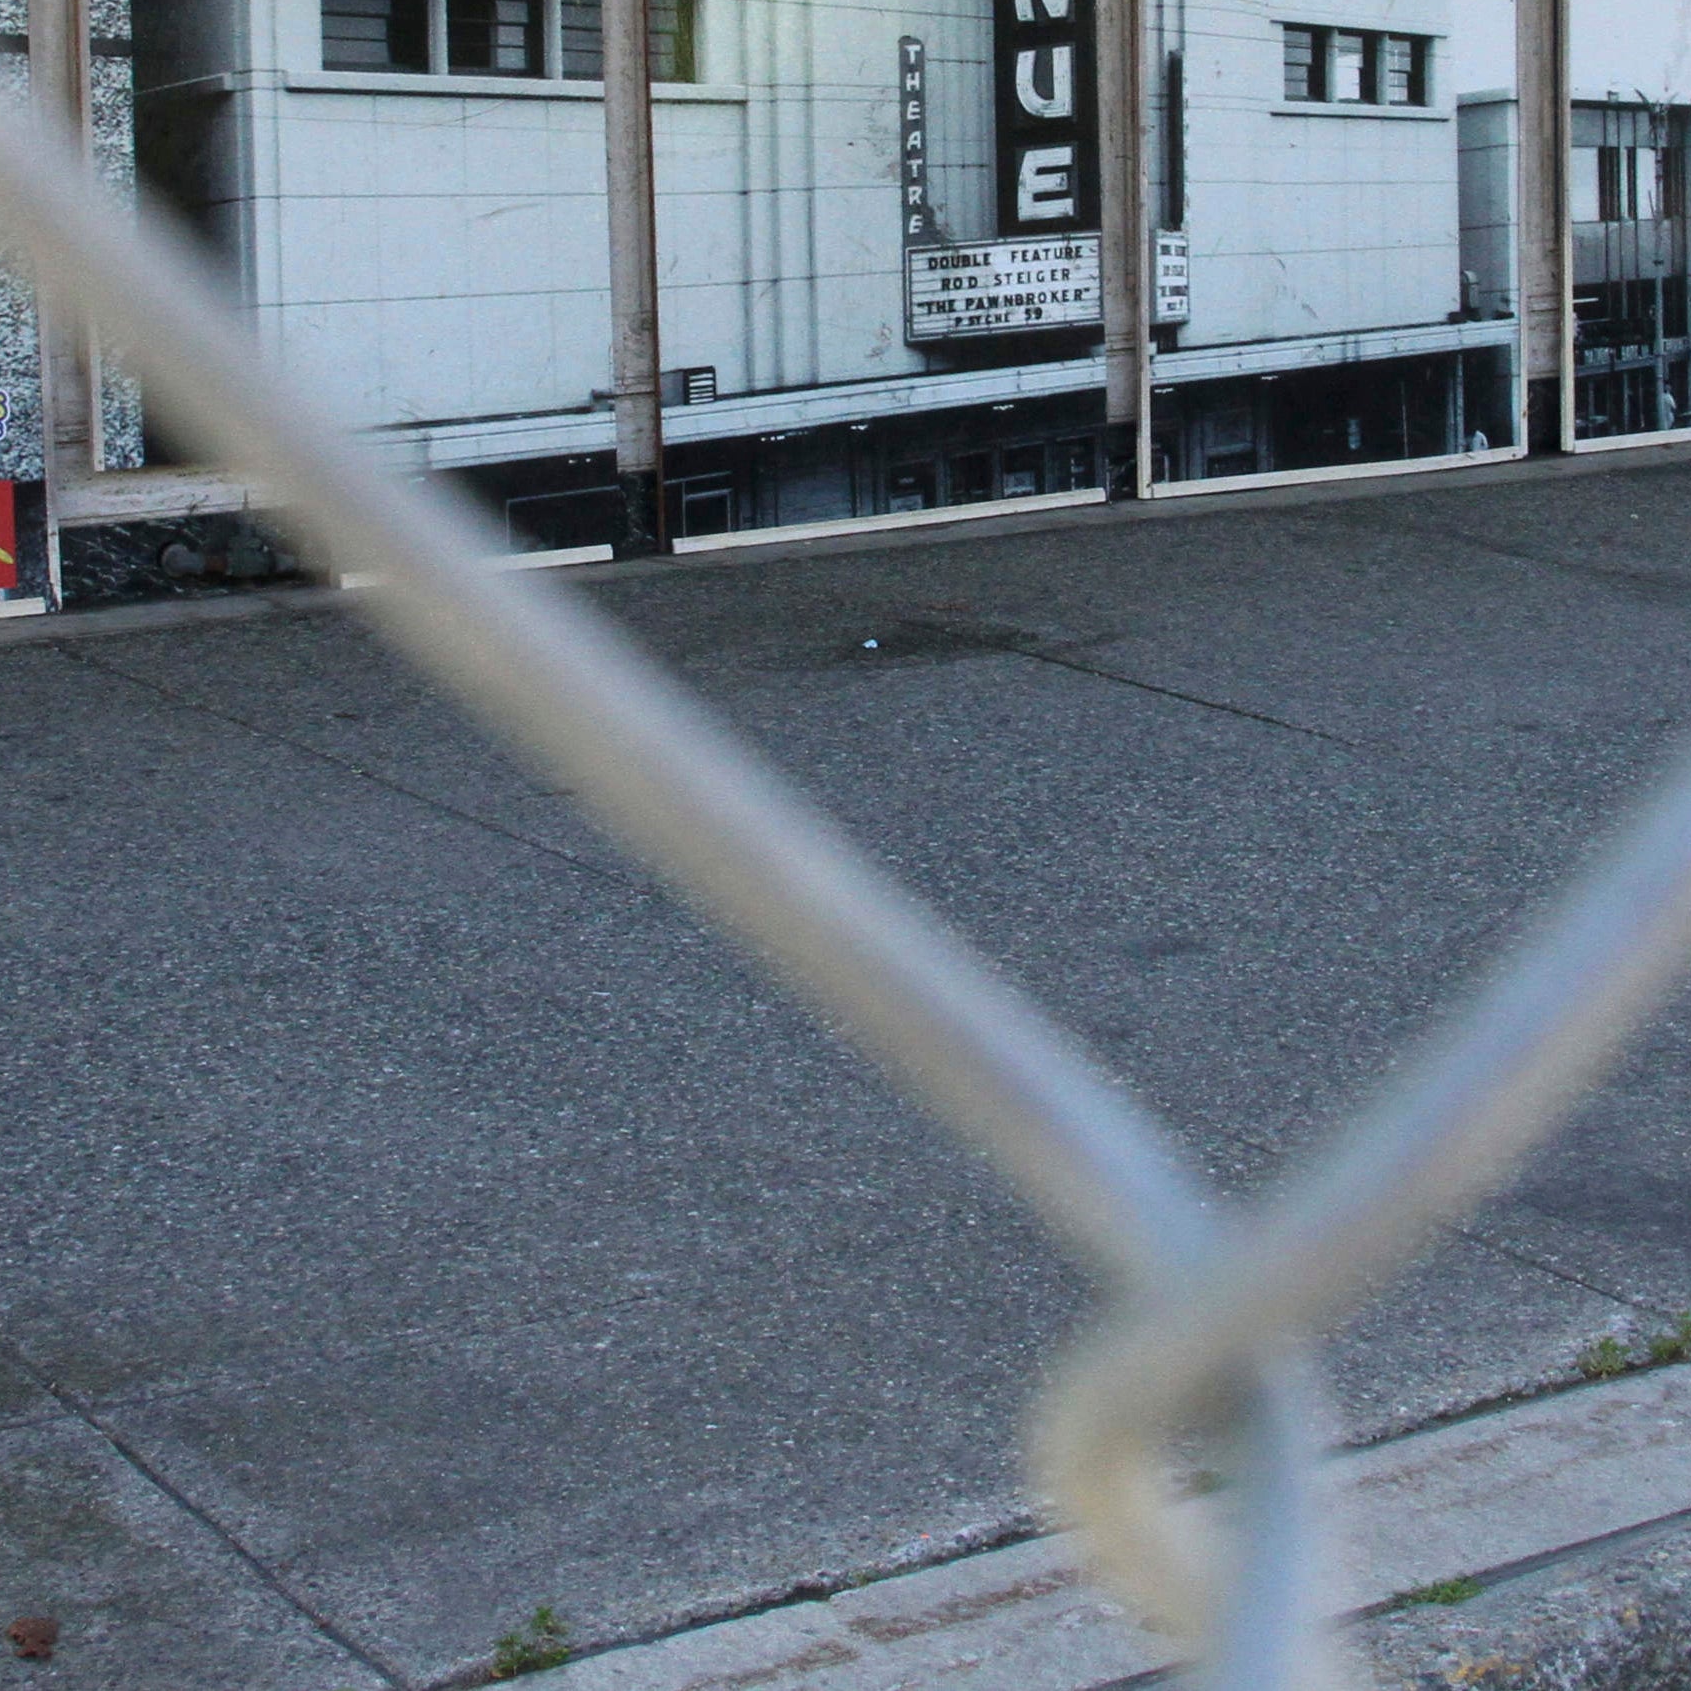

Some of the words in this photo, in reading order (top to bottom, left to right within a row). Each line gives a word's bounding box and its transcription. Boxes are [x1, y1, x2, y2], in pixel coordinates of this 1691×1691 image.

[904, 44, 923, 236] THEATRE
[928, 252, 991, 270] DOUBLE
[1011, 245, 1083, 263] FEATURE
[941, 276, 979, 291] ROD
[994, 268, 1071, 287] STEIGER
[1024, 306, 1043, 321] 59
